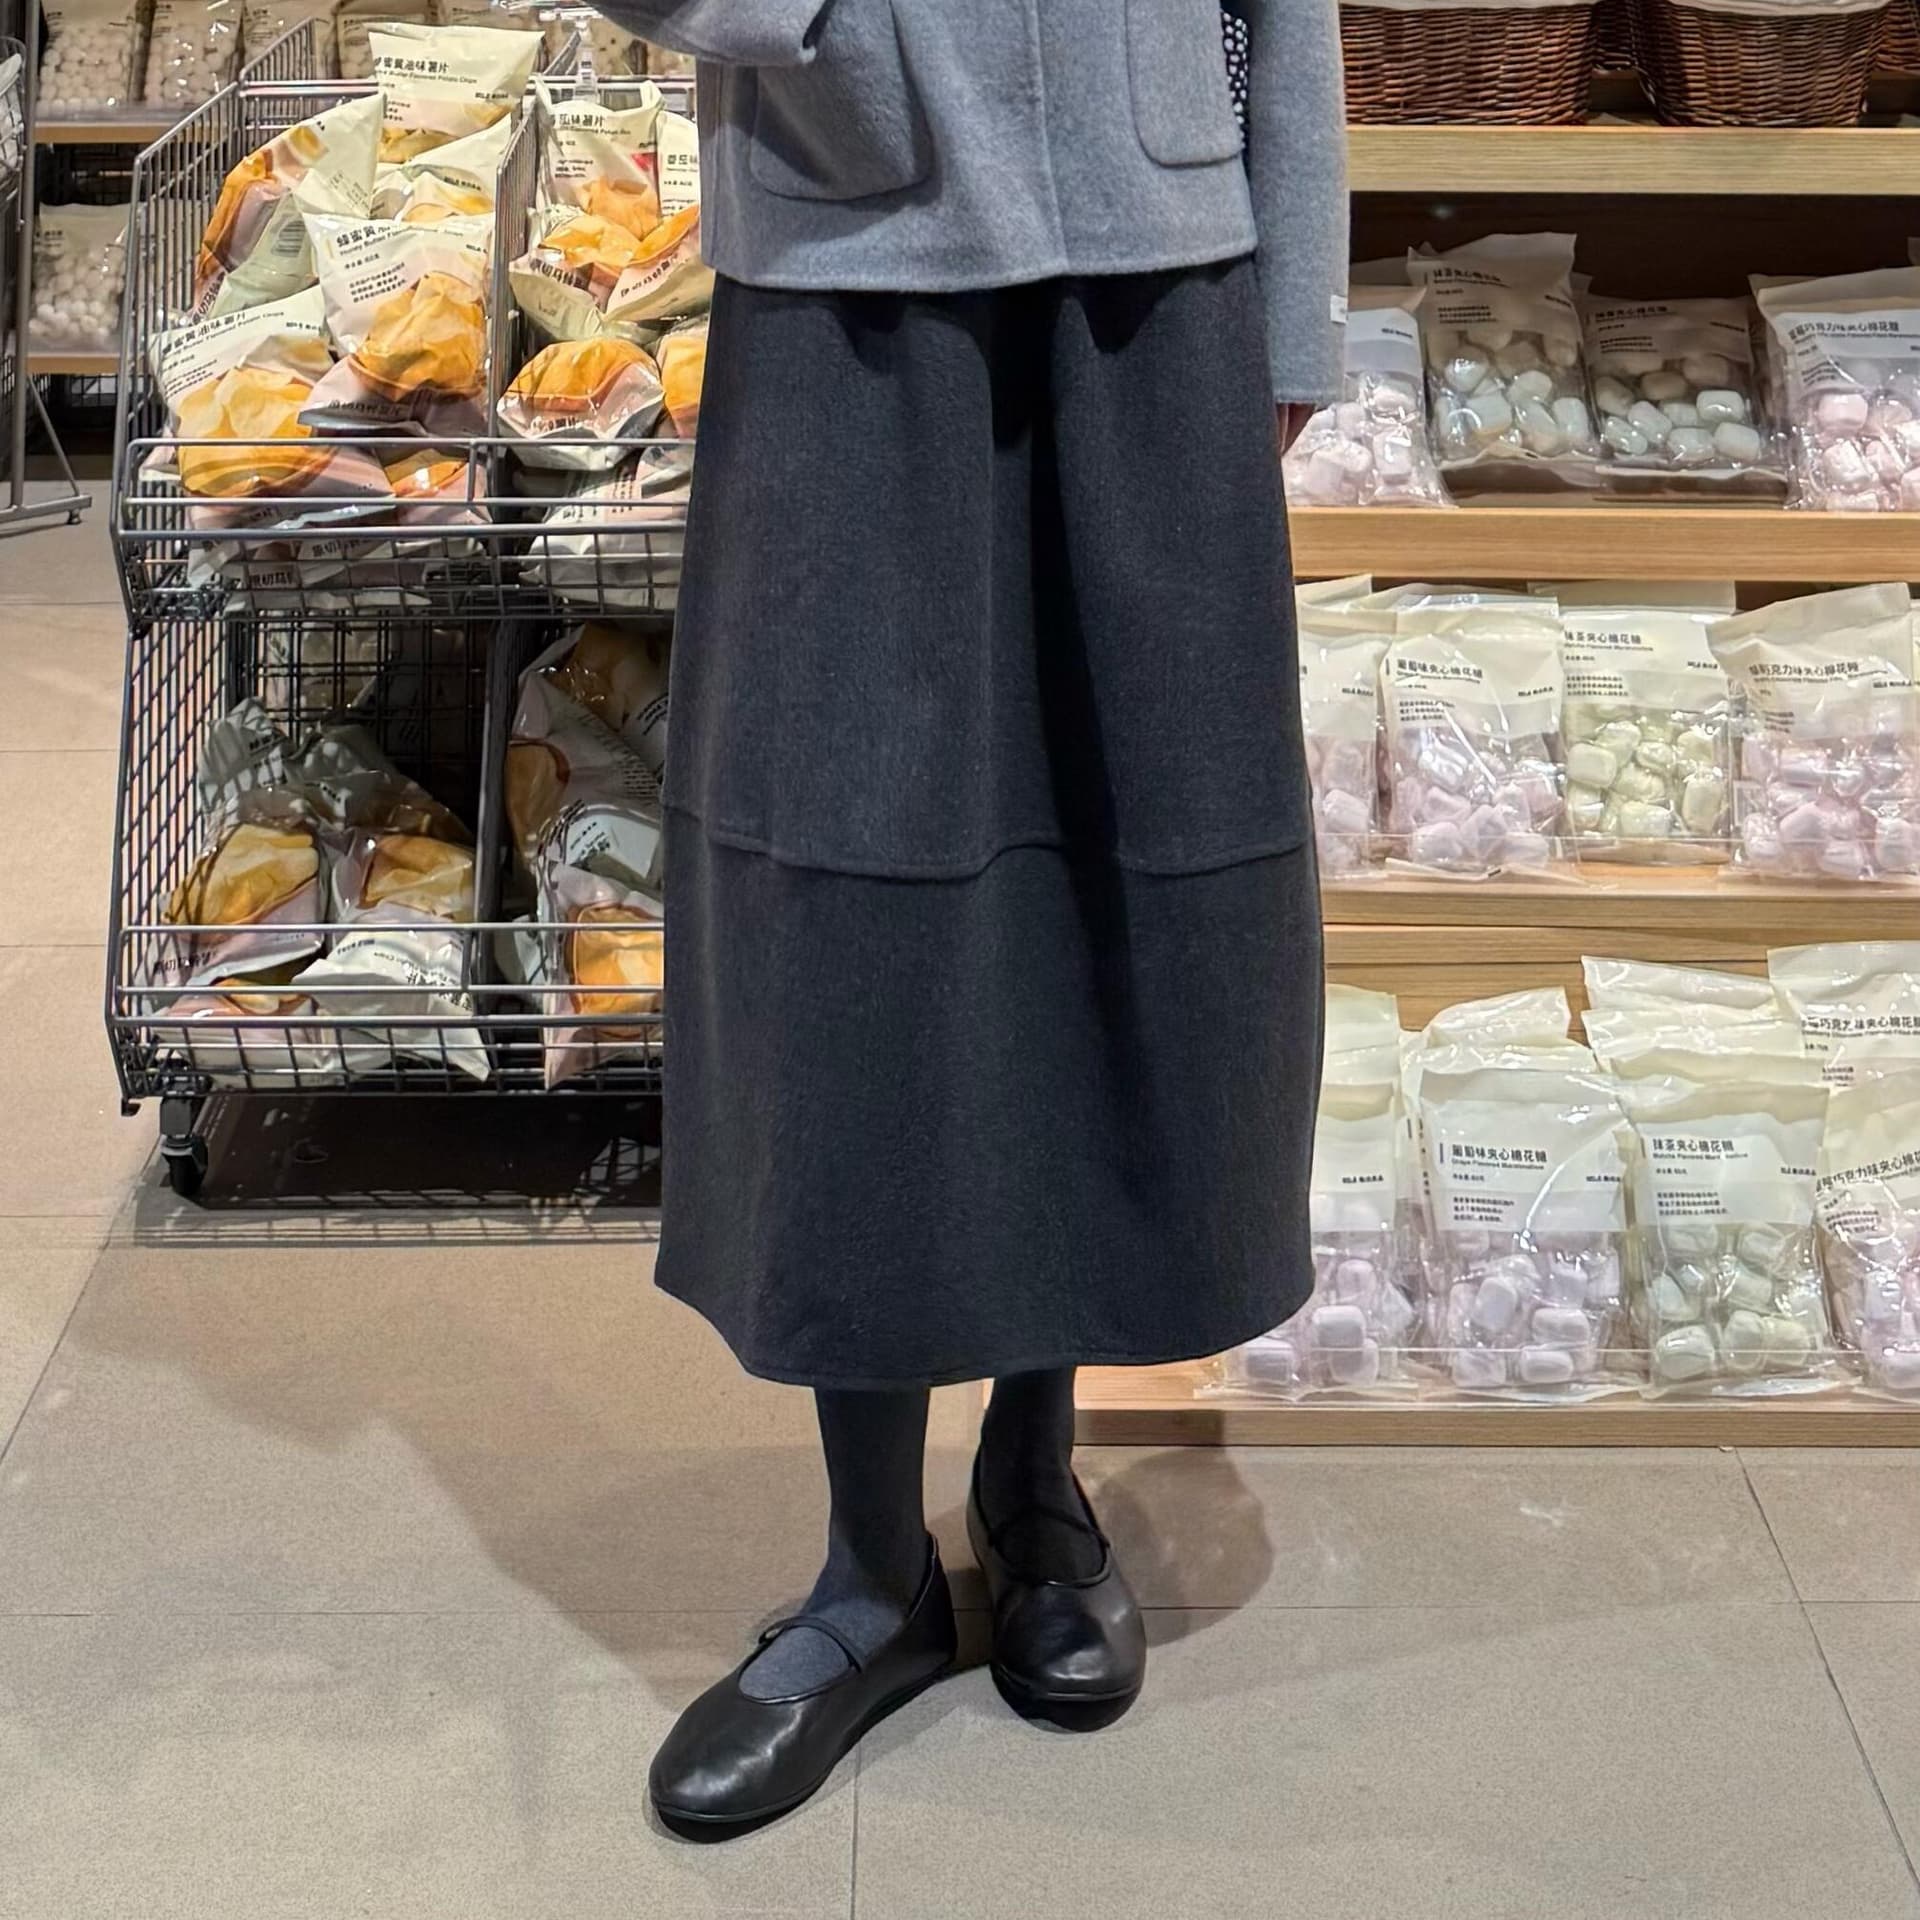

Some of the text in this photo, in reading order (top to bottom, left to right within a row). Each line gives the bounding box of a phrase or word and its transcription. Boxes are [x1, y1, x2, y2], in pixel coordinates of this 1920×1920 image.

[1452, 1143, 1547, 1163] 葡萄味夹心棉花糖
[1652, 1138, 1734, 1152] 抹茶夹心棉花糖
